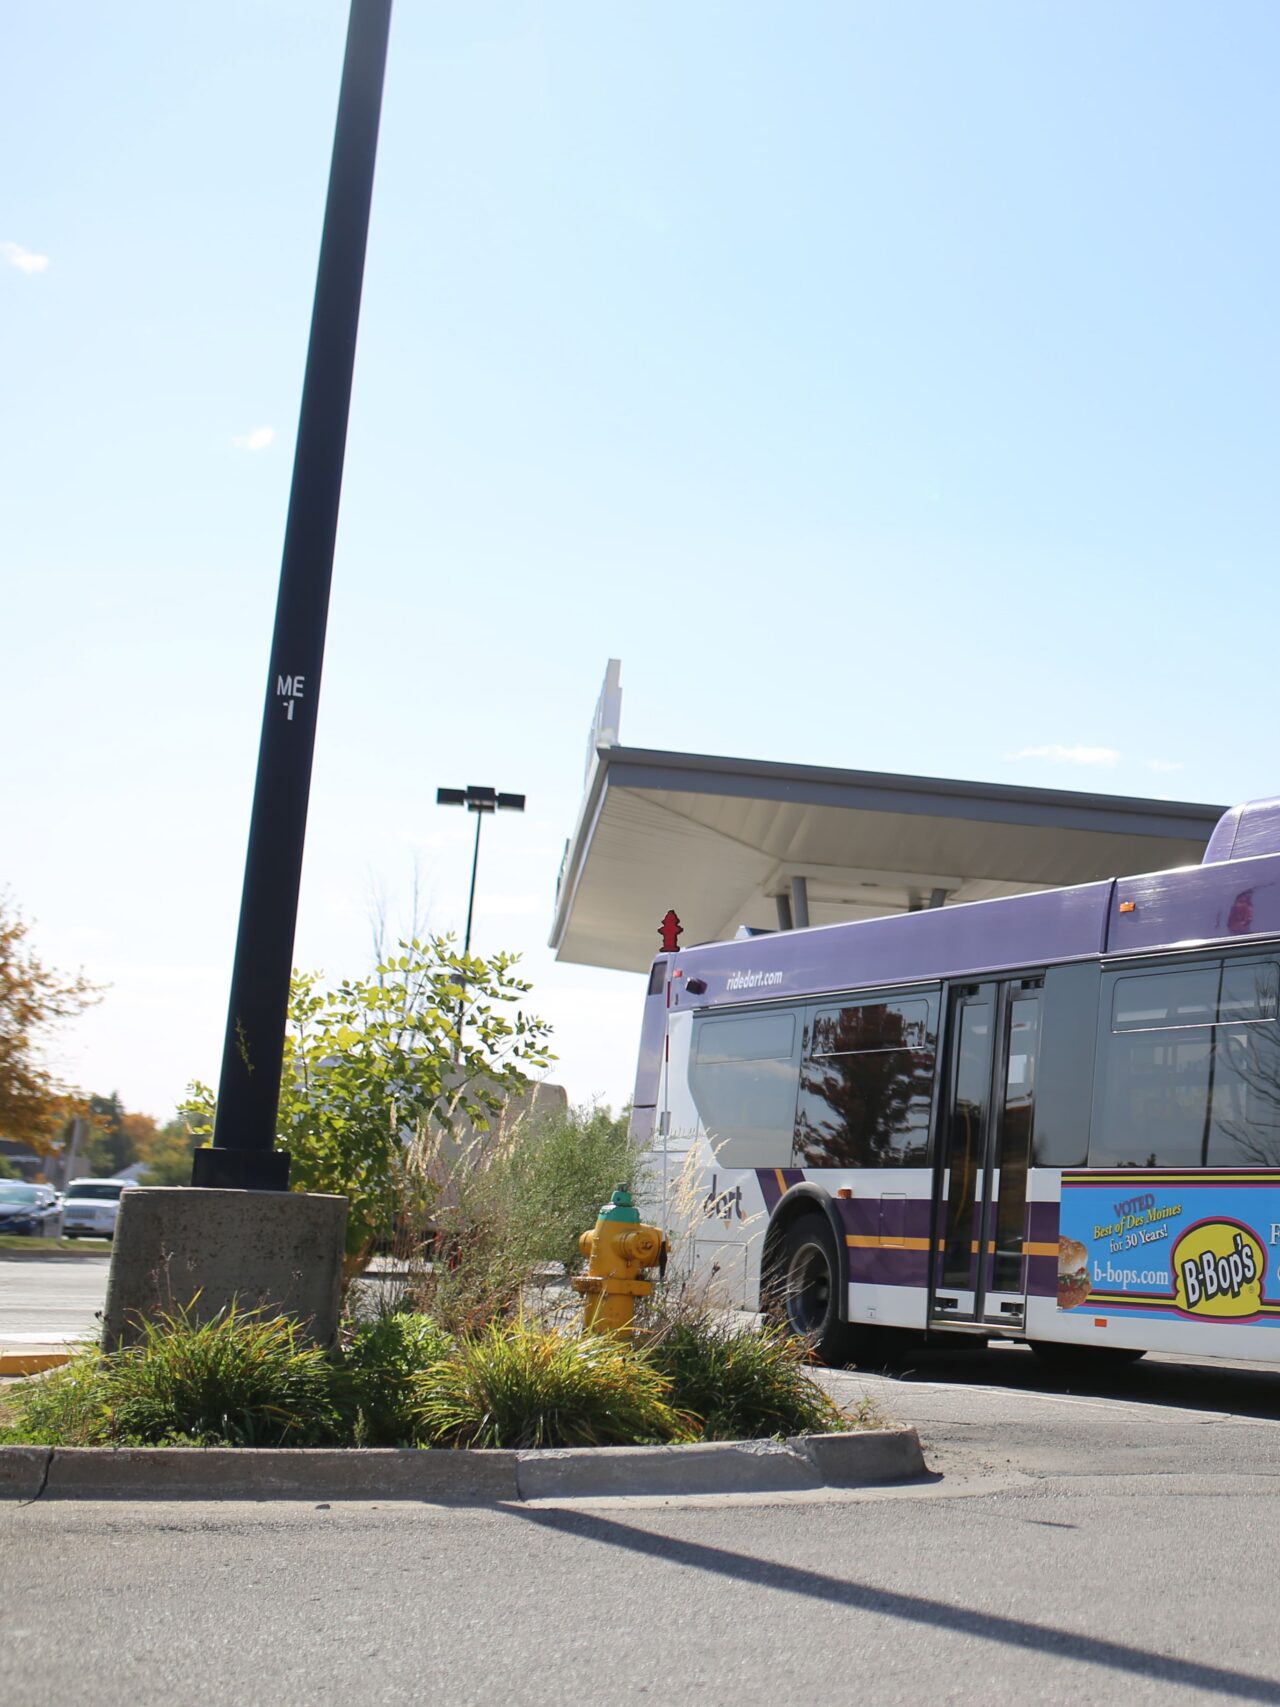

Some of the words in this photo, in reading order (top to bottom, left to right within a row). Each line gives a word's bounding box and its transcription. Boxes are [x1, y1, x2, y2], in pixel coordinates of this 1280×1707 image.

[277, 675, 305, 697] ME
[282, 700, 294, 720] 1
[726, 969, 783, 991] ridedart.com
[1113, 1193, 1156, 1218] VOTED
[1093, 1225, 1113, 1240] Best
[1115, 1218, 1126, 1236] of
[1126, 1213, 1145, 1231] Des
[1146, 1203, 1183, 1224] Moines
[1110, 1238, 1123, 1253] for
[1125, 1234, 1138, 1249] 30
[1140, 1223, 1169, 1245] Years!
[1093, 1259, 1169, 1290] b-bops.com
[1181, 1233, 1256, 1308] B-Bop's
